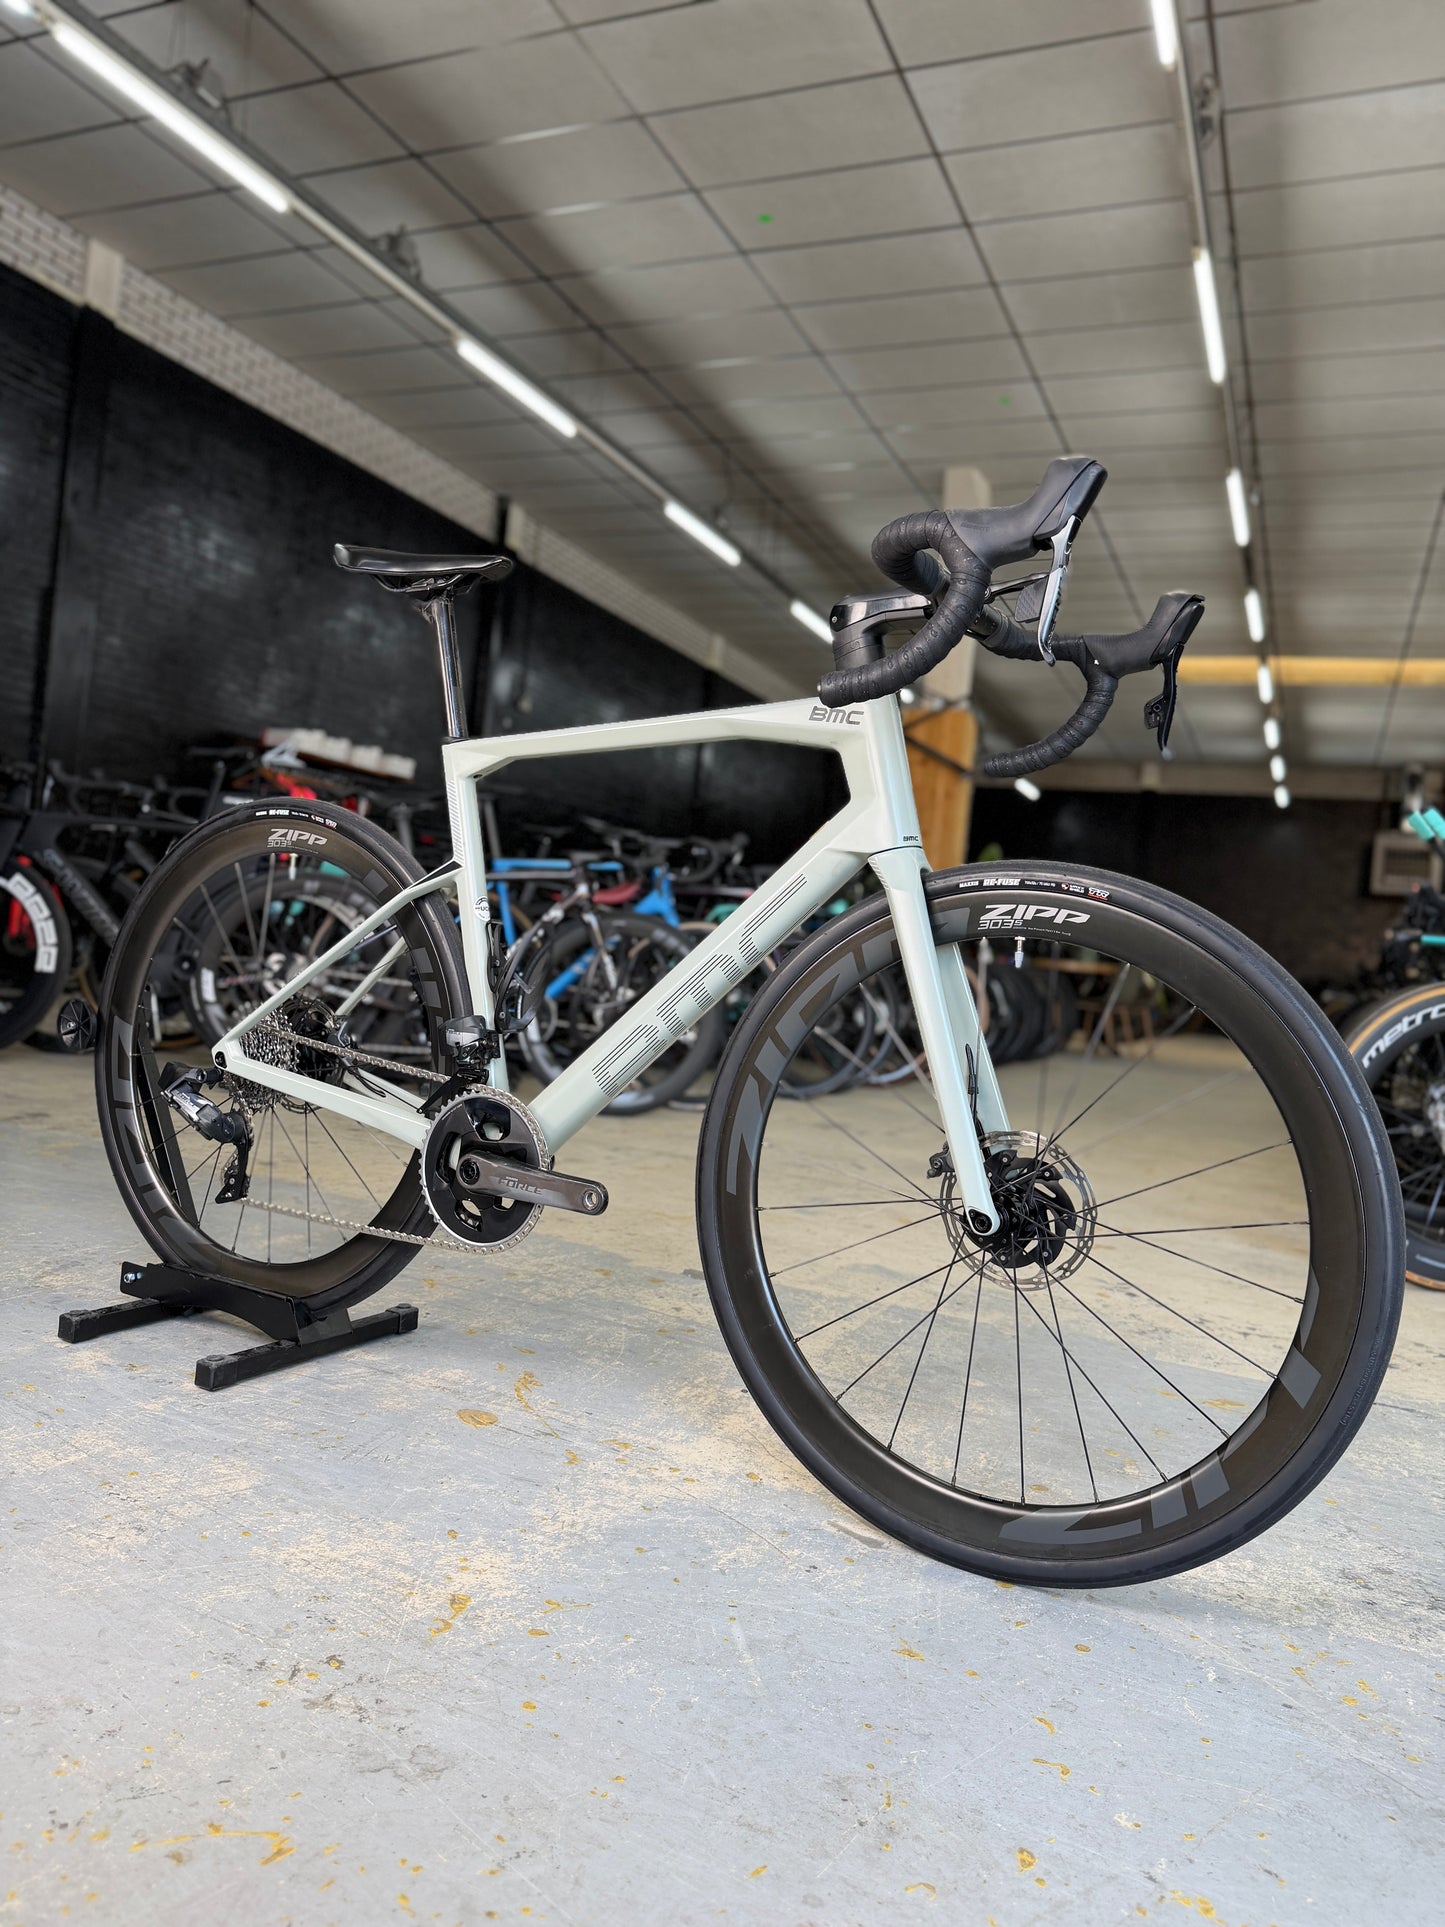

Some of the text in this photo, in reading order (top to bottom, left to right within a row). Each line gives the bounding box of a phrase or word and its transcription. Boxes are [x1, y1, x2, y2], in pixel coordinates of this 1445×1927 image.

[809, 705, 865, 726] BMC
[268, 828, 328, 846] ZIPP
[983, 878, 1021, 887] RE-FUSE
[980, 904, 1091, 924] ZIPP
[978, 919, 1024, 930] 303S
